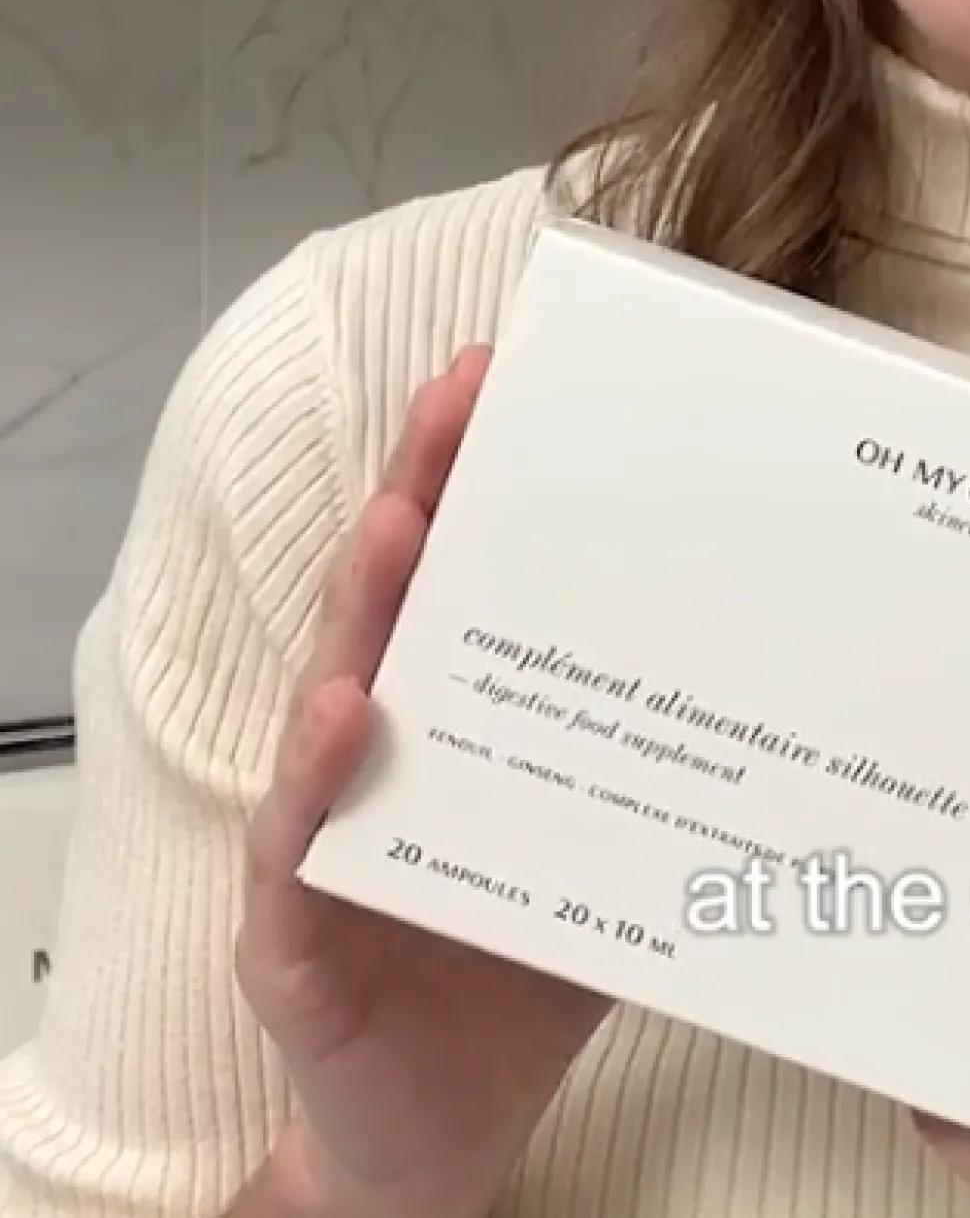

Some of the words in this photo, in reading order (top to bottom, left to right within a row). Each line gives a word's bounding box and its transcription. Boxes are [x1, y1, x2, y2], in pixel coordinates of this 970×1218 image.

[855, 437, 904, 474] OH
[912, 458, 968, 495] MY
[461, 625, 642, 702] complément
[645, 687, 820, 768] alimentaire
[824, 749, 970, 821] silhouette
[472, 670, 567, 722] digestive
[564, 708, 622, 739] food
[619, 729, 747, 785] supplement
[386, 836, 423, 866] 20
[427, 858, 531, 907] AMPOULES
[553, 895, 591, 926] 20
[614, 919, 645, 946] 10
